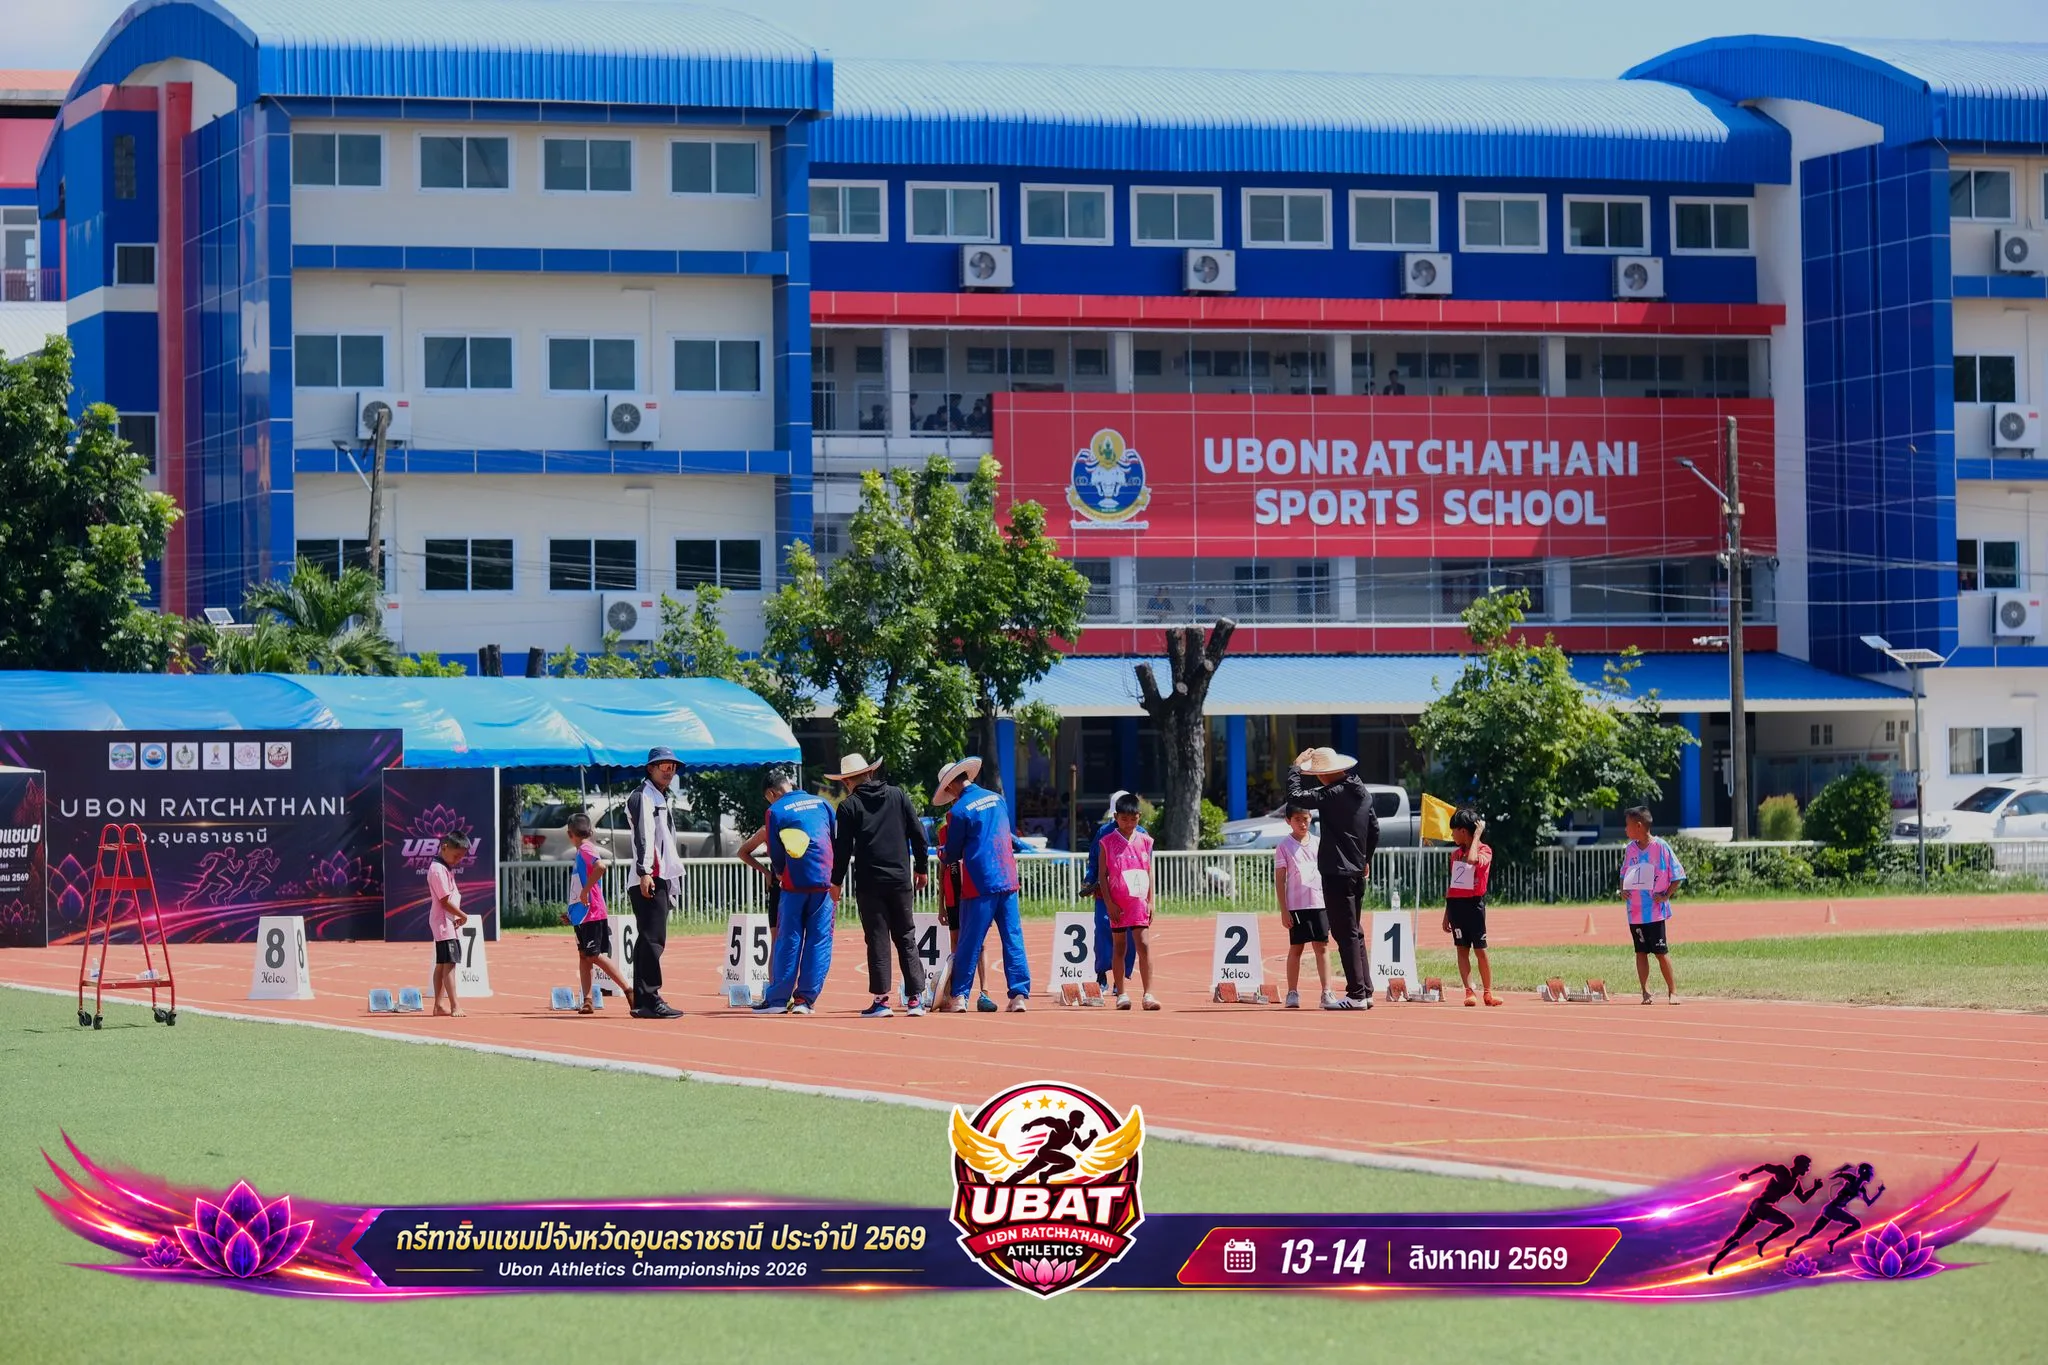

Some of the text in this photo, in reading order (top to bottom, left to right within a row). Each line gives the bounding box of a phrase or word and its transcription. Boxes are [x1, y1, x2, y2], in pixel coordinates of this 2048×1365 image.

[1203, 438, 1639, 476] UBONRATCHATHANI
[1255, 488, 1606, 526] SPORTS SCHOOL
[60, 796, 345, 818] UBON RATCHATHANI
[401, 837, 481, 857] UBN
[12, 872, 29, 882] 2569
[1453, 866, 1466, 885] 2
[1631, 867, 1645, 885] 1
[265, 928, 286, 969] 8
[296, 929, 305, 969] 8
[462, 928, 477, 968] 7
[623, 925, 634, 965] 6
[729, 926, 742, 966] 5
[753, 926, 768, 966] 5
[916, 925, 940, 965] 4
[1063, 924, 1088, 964] 3
[1224, 925, 1249, 964] 2
[1384, 923, 1401, 963] 1
[261, 971, 286, 983] Nelco
[1220, 967, 1250, 979] Nelco
[1377, 964, 1405, 976] Nelco
